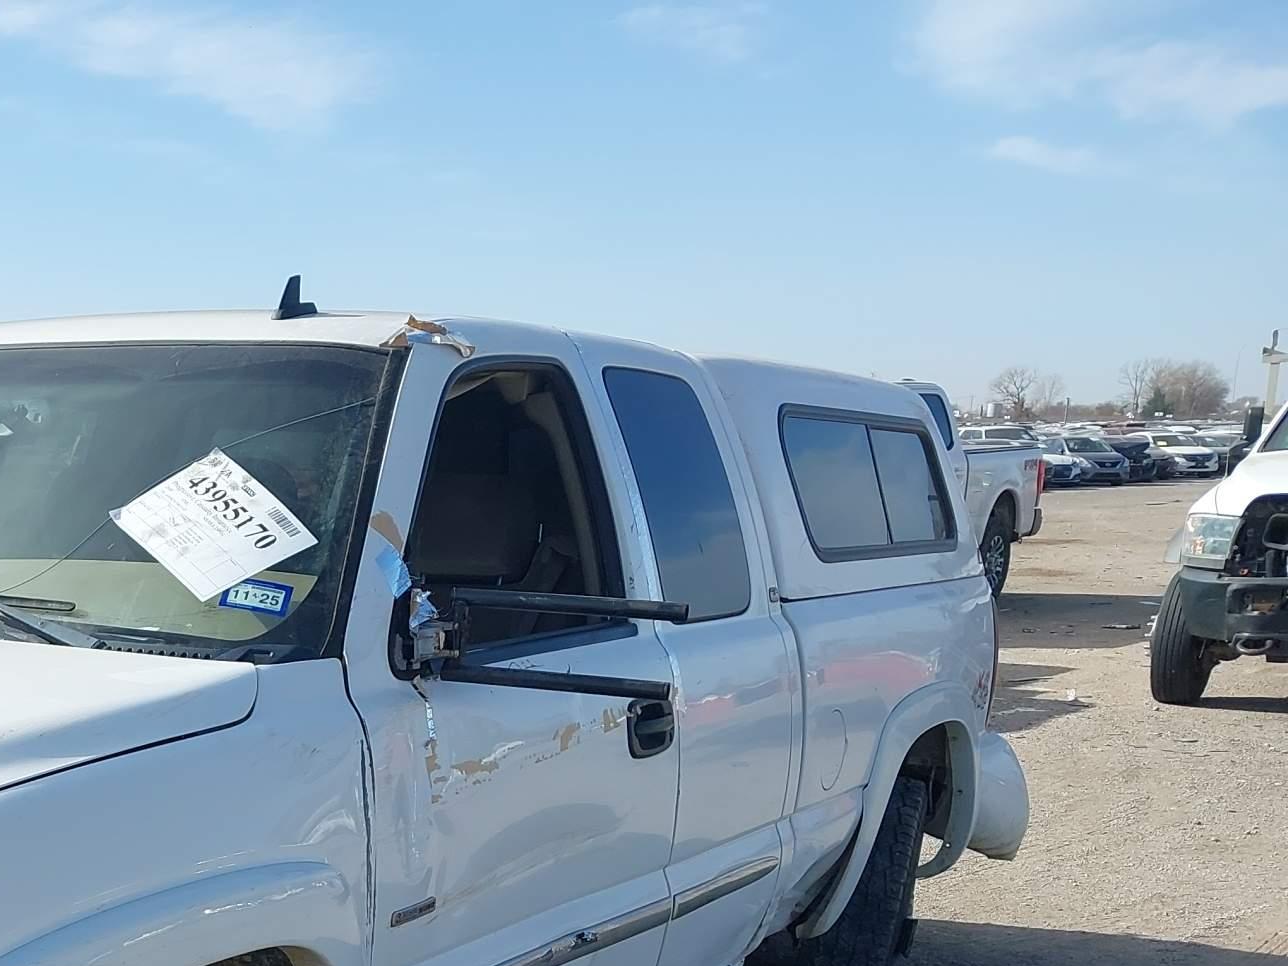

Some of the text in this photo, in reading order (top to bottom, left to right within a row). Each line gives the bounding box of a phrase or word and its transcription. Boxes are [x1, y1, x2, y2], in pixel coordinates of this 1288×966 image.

[188, 476, 277, 549] 43955170
[232, 589, 250, 601] 11
[259, 592, 281, 606] 25
